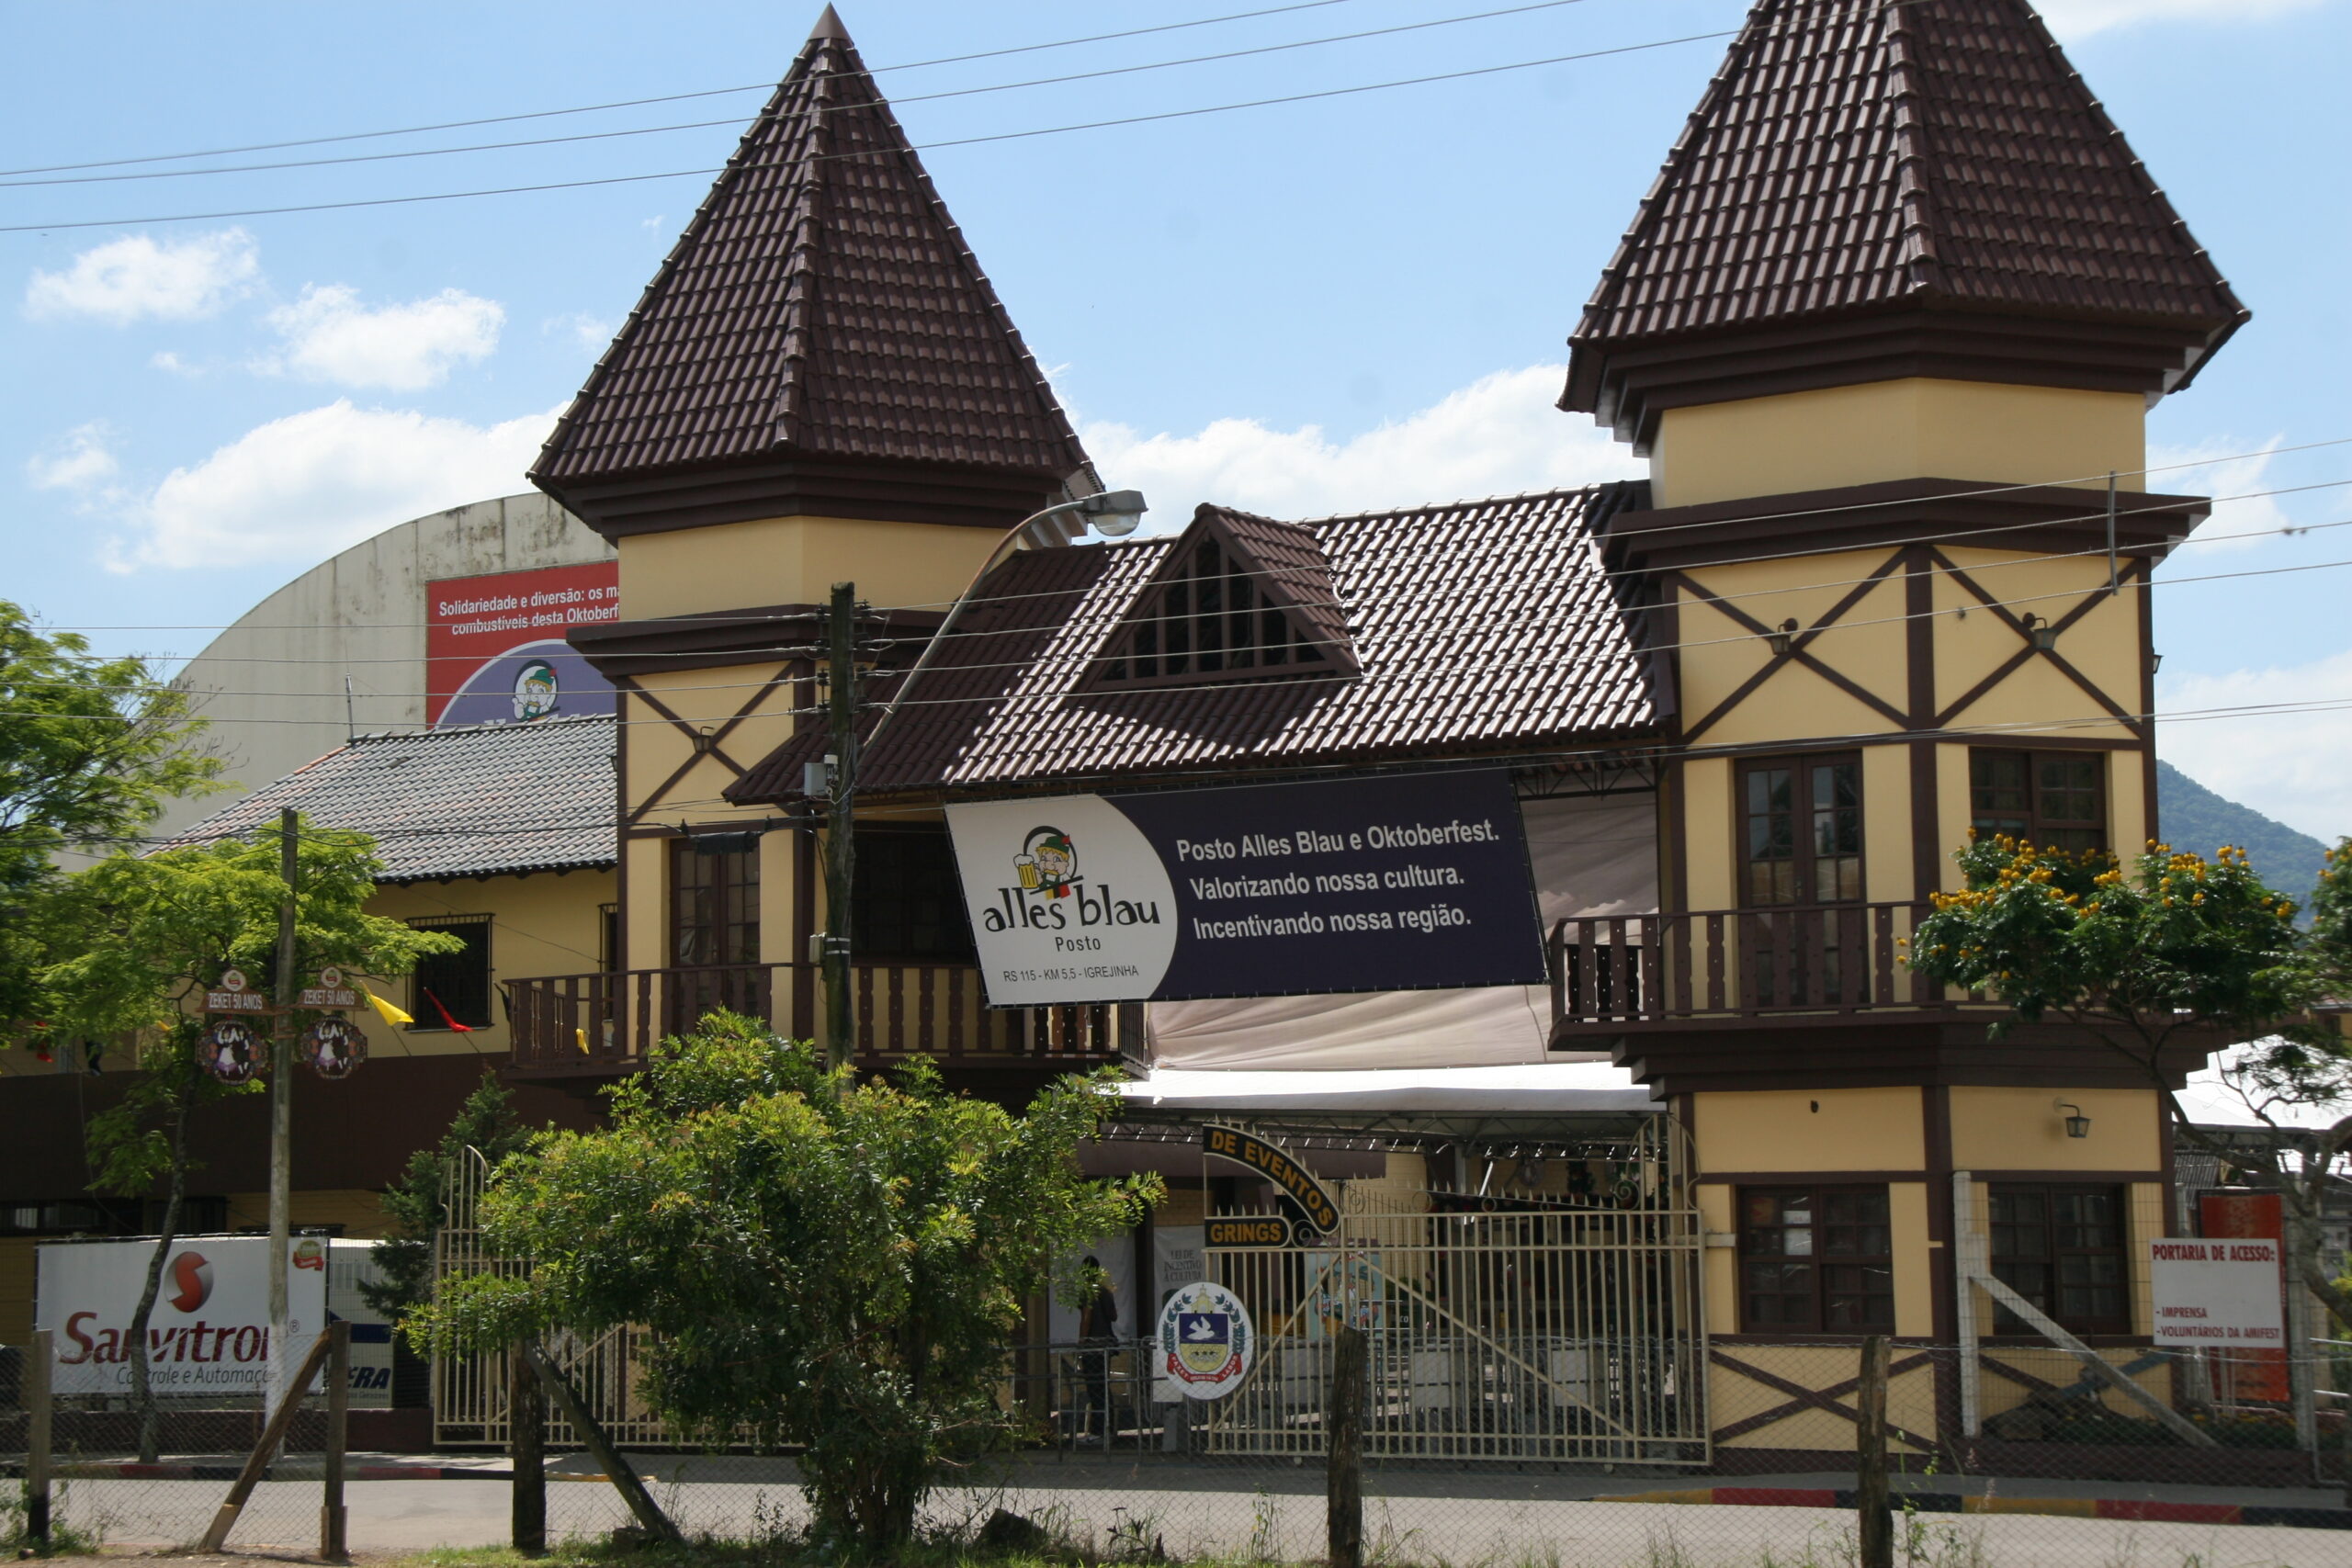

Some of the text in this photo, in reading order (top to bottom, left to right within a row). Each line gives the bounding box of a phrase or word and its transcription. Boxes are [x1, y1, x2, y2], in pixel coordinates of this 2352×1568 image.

[439, 596, 517, 616] Solidariedade
[521, 597, 528, 608] e
[530, 588, 584, 607] diversão:
[588, 587, 603, 601] os
[452, 603, 619, 636] combustíveis desta Oktoberf
[1176, 818, 1499, 862] Posto Alles Blau e Oktoberfest.
[1190, 864, 1464, 900] Valorizando nossa cultura.
[983, 884, 1160, 932] alles blau
[1193, 903, 1472, 940] Incentivando nossa região.
[1055, 935, 1102, 952] Posto
[1003, 970, 1018, 983] RS
[1020, 969, 1036, 982] 115
[1044, 968, 1060, 981] KM
[1061, 967, 1077, 981] 5,5
[1084, 965, 1139, 979] IGREJINHA
[208, 993, 263, 1010] ZEKET 50 ANOS
[303, 989, 356, 1005] ZEKET 50 ANOS
[1211, 1131, 1333, 1226] DE EVENTOS
[1210, 1223, 1282, 1243] GRINGS
[2152, 1244, 2276, 1261] PORTARIA DE ACESSO:
[2162, 1306, 2208, 1318] IMPRENSA
[2227, 1327, 2240, 1338] DA
[2244, 1327, 2279, 1339] AMIFEST
[183, 1370, 192, 1384] e
